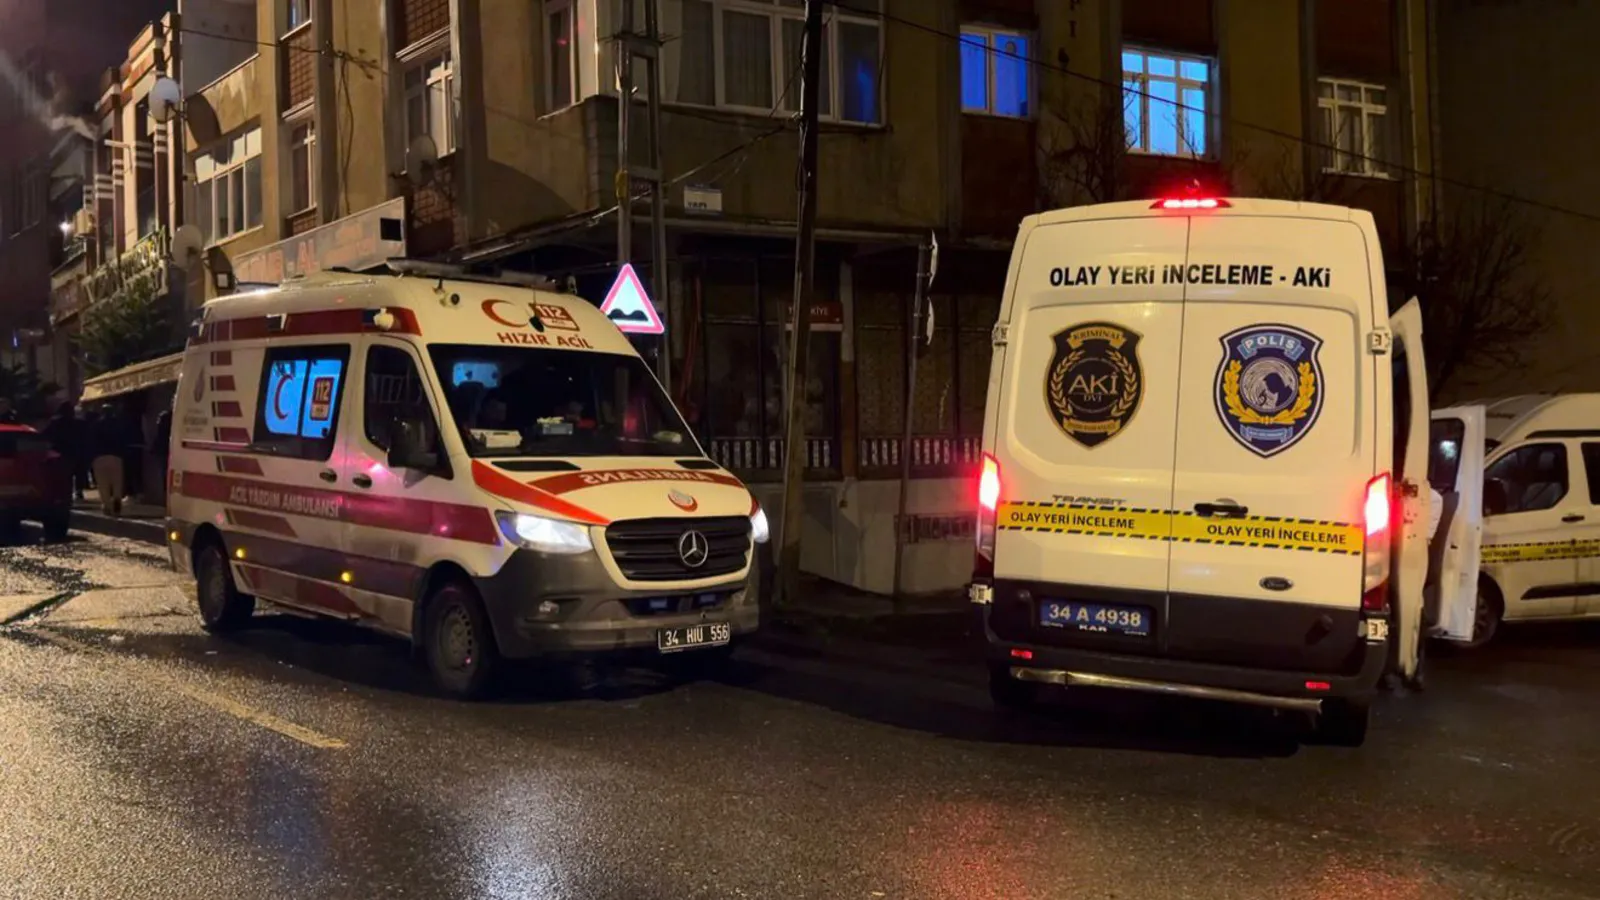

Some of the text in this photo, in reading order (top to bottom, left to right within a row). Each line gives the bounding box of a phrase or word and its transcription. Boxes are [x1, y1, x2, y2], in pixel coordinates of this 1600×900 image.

[1050, 266, 1101, 286] OLAY
[535, 304, 569, 318] 112
[497, 332, 595, 350] HIZIR ACİL
[1244, 334, 1296, 350] POLİS
[315, 379, 331, 401] 112
[1068, 371, 1120, 394] AKİ
[1010, 511, 1347, 544] OLAY YERİ İNCELEME OLAY YERİ İNCELEME
[1049, 603, 1142, 628] 34 A 4938
[665, 630, 680, 647] 34
[710, 624, 728, 641] 556
